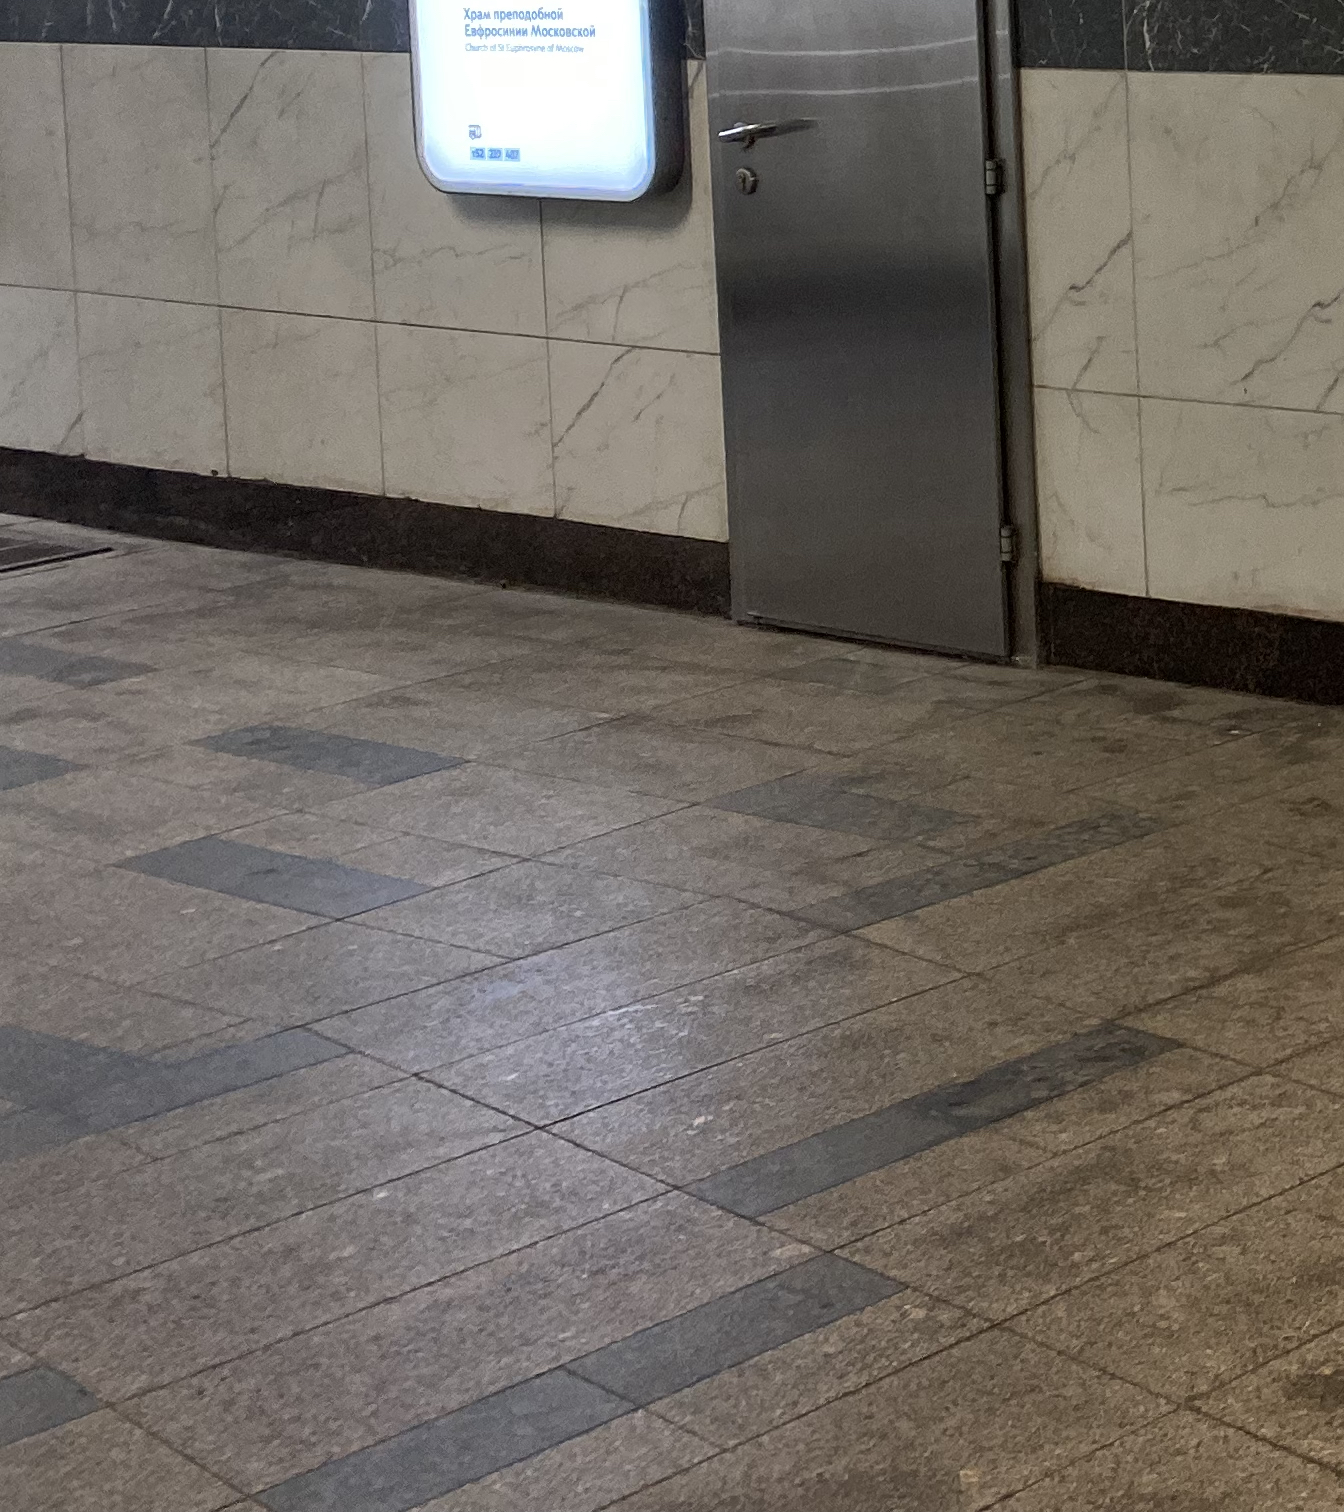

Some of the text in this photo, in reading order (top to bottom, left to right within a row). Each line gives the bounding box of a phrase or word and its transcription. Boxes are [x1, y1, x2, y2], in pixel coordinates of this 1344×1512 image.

[463, 6, 564, 23] Храм преподобной
[464, 23, 596, 40] Евфросинии Московской
